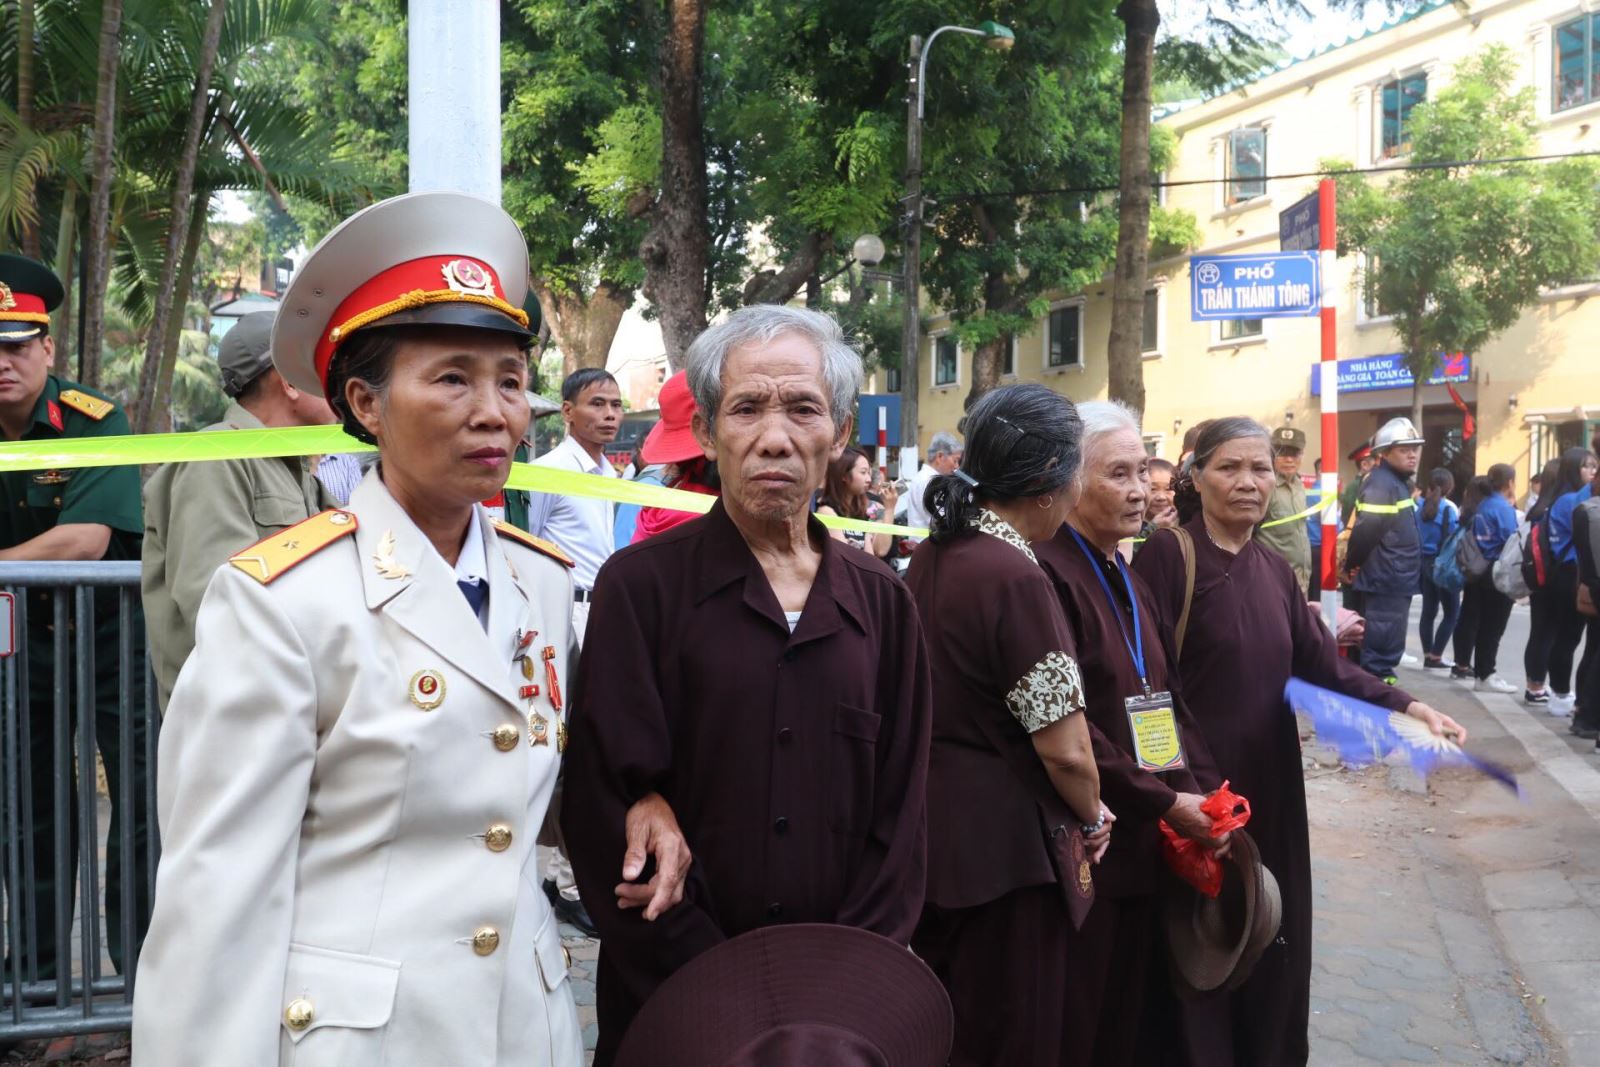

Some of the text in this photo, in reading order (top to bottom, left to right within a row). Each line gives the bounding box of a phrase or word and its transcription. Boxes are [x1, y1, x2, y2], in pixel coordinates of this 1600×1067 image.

[1234, 261, 1275, 280] PHỐ
[1235, 282, 1275, 308] THÁNH
[1278, 280, 1310, 307] TÔNG
[1350, 361, 1367, 372] NHÀ
